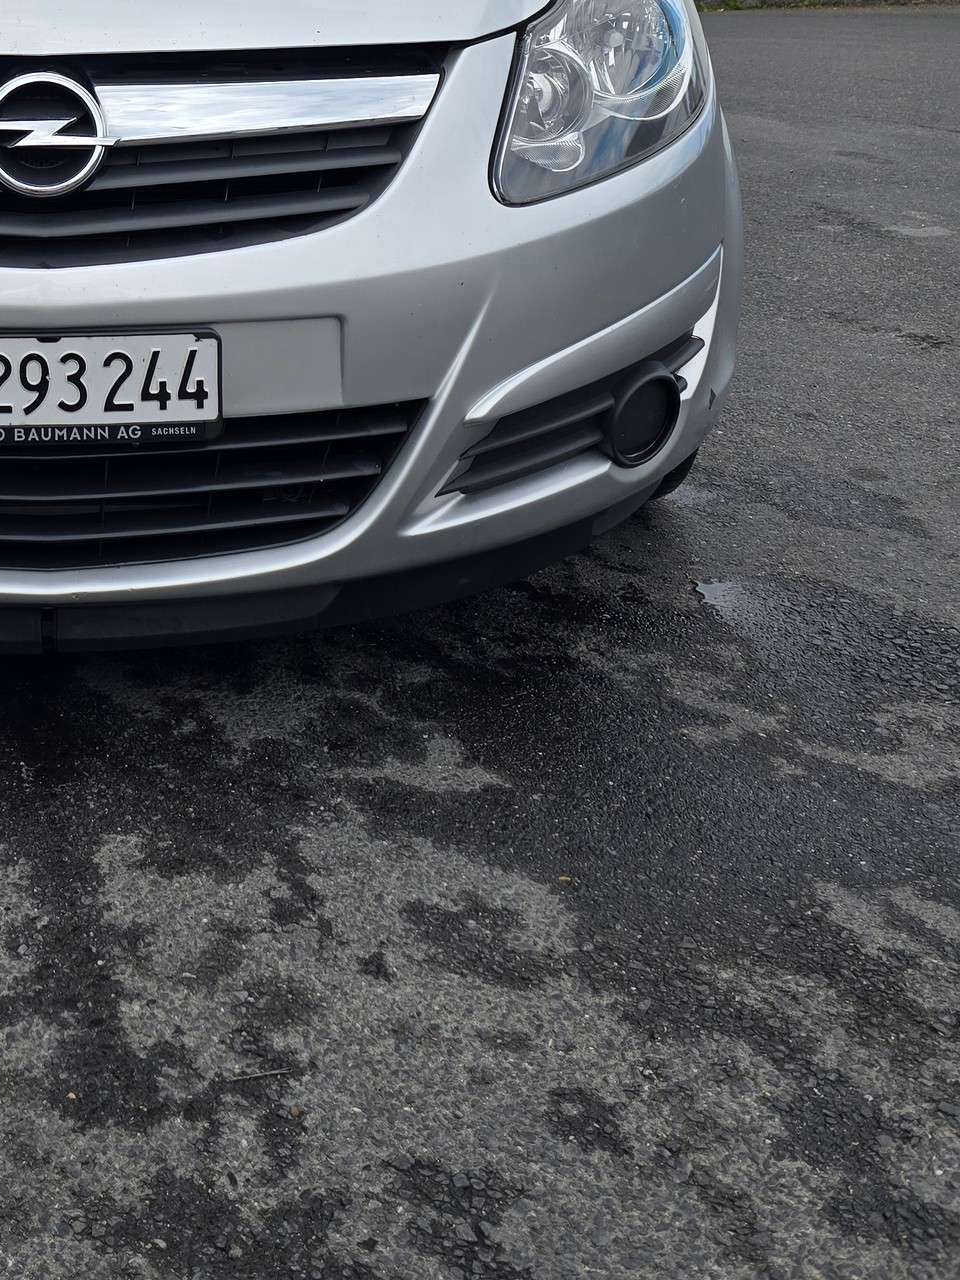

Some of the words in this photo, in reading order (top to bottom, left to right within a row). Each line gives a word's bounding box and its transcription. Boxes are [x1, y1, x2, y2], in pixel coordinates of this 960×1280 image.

[14, 426, 109, 441] BAUMANN
[117, 425, 142, 439] AG
[151, 427, 196, 435] SACHSELN
